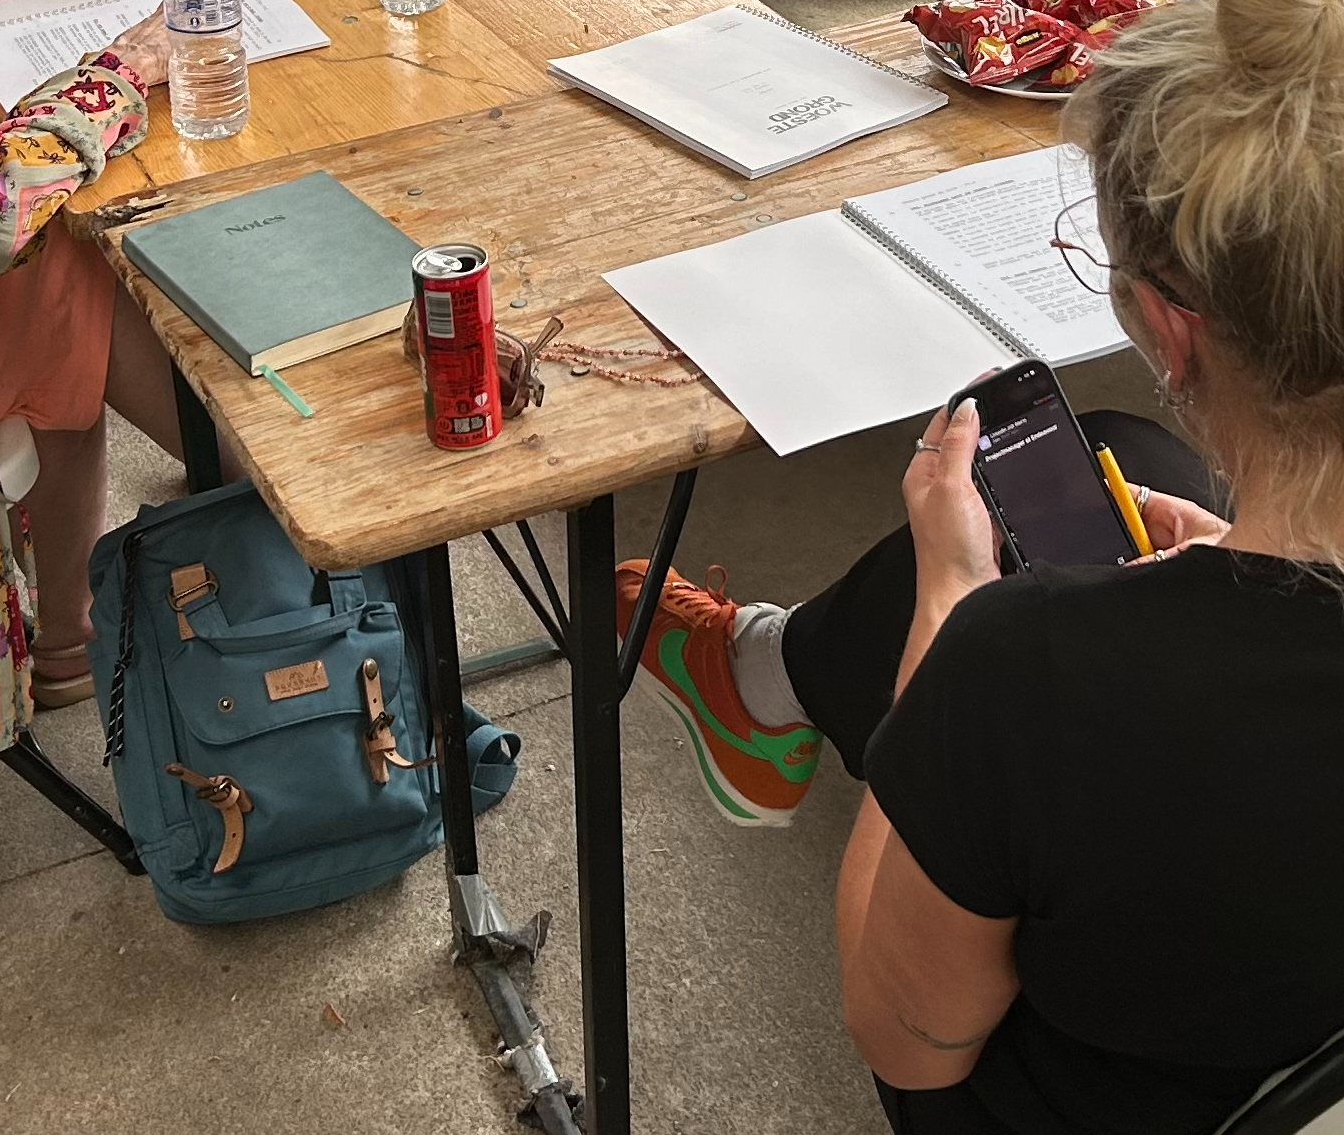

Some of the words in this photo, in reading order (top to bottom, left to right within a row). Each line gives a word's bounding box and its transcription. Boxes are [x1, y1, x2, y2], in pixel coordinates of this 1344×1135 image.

[766, 100, 854, 135] WOESTE
[768, 95, 836, 123] GROND
[224, 214, 287, 236] Notes
